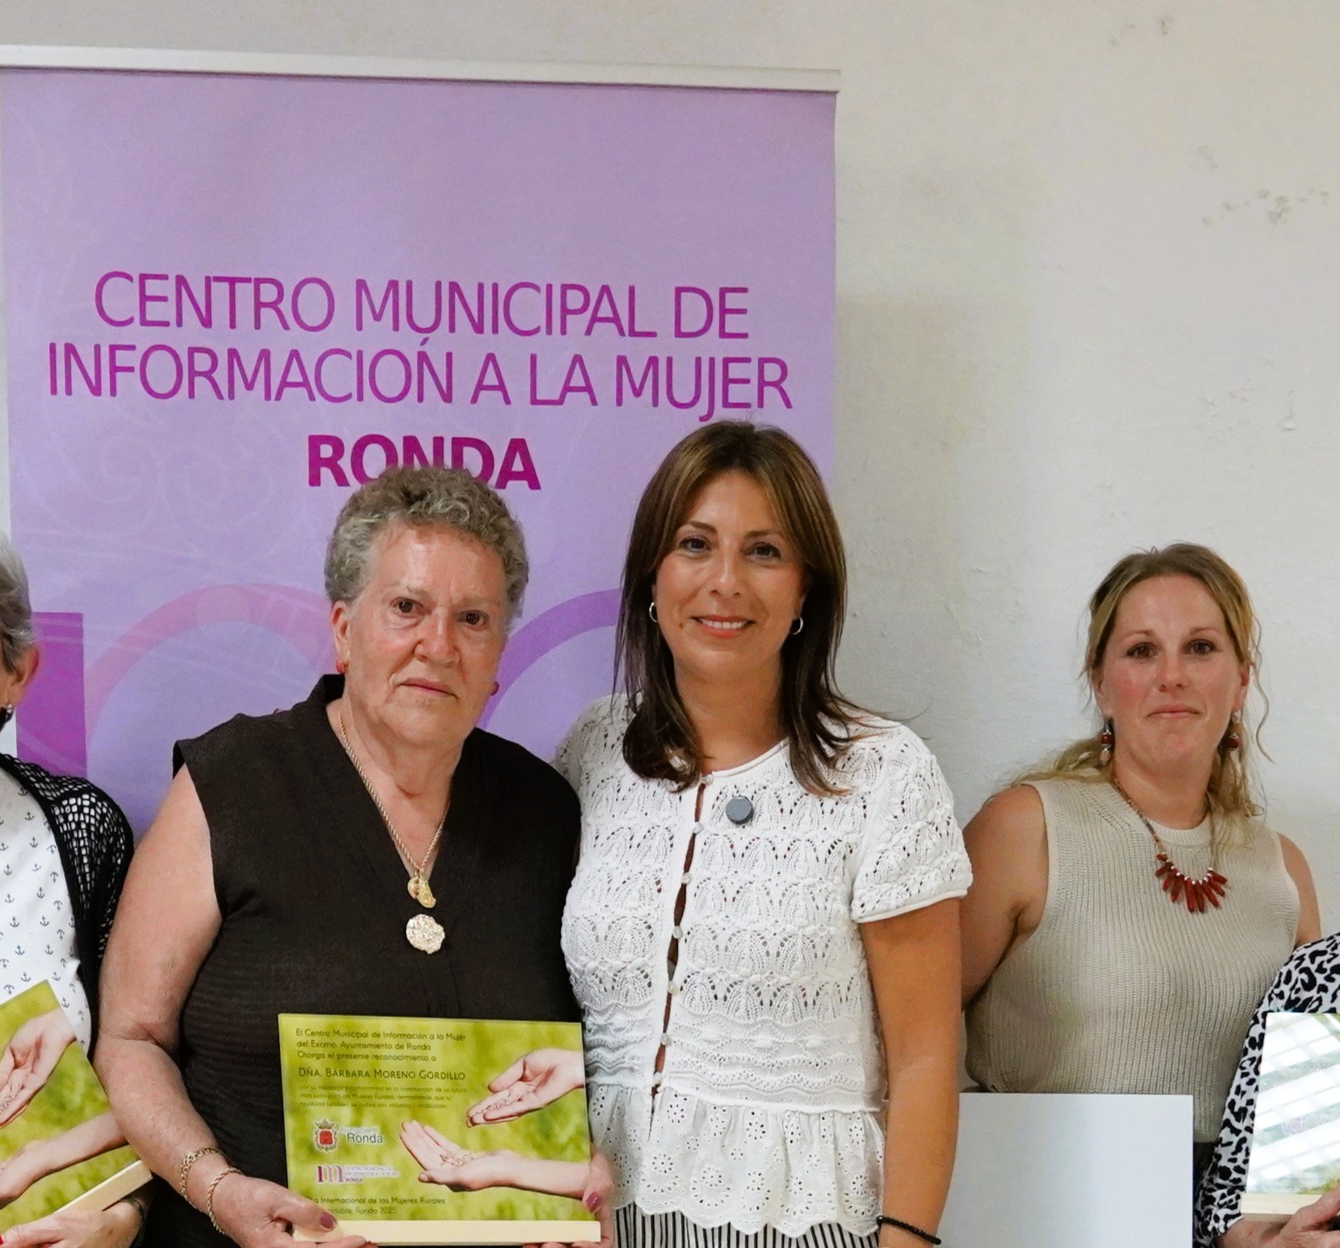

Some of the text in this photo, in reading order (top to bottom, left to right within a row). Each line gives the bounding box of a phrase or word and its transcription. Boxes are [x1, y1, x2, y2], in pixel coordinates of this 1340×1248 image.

[95, 271, 749, 339] CENTRO MUNICIPAL DE
[49, 338, 792, 422] INFORMACIÓN A LA MUJER
[308, 433, 541, 490] RONDA
[295, 1027, 302, 1036] El
[304, 1028, 330, 1037] Centro
[332, 1028, 368, 1039] Municipal
[436, 1032, 444, 1040] la
[445, 1032, 466, 1041] Mujer
[296, 1039, 308, 1047] del
[339, 1040, 393, 1049] Ayuntamiento
[394, 1042, 404, 1050] de
[406, 1042, 431, 1050] Ronda
[296, 1050, 325, 1059] Otorga
[373, 1068, 416, 1079] MORENO
[418, 1069, 465, 1080] GORDILLO
[346, 1131, 383, 1143] Ronda
[390, 1196, 417, 1205] Mujeres
[419, 1196, 445, 1204] Rurales
